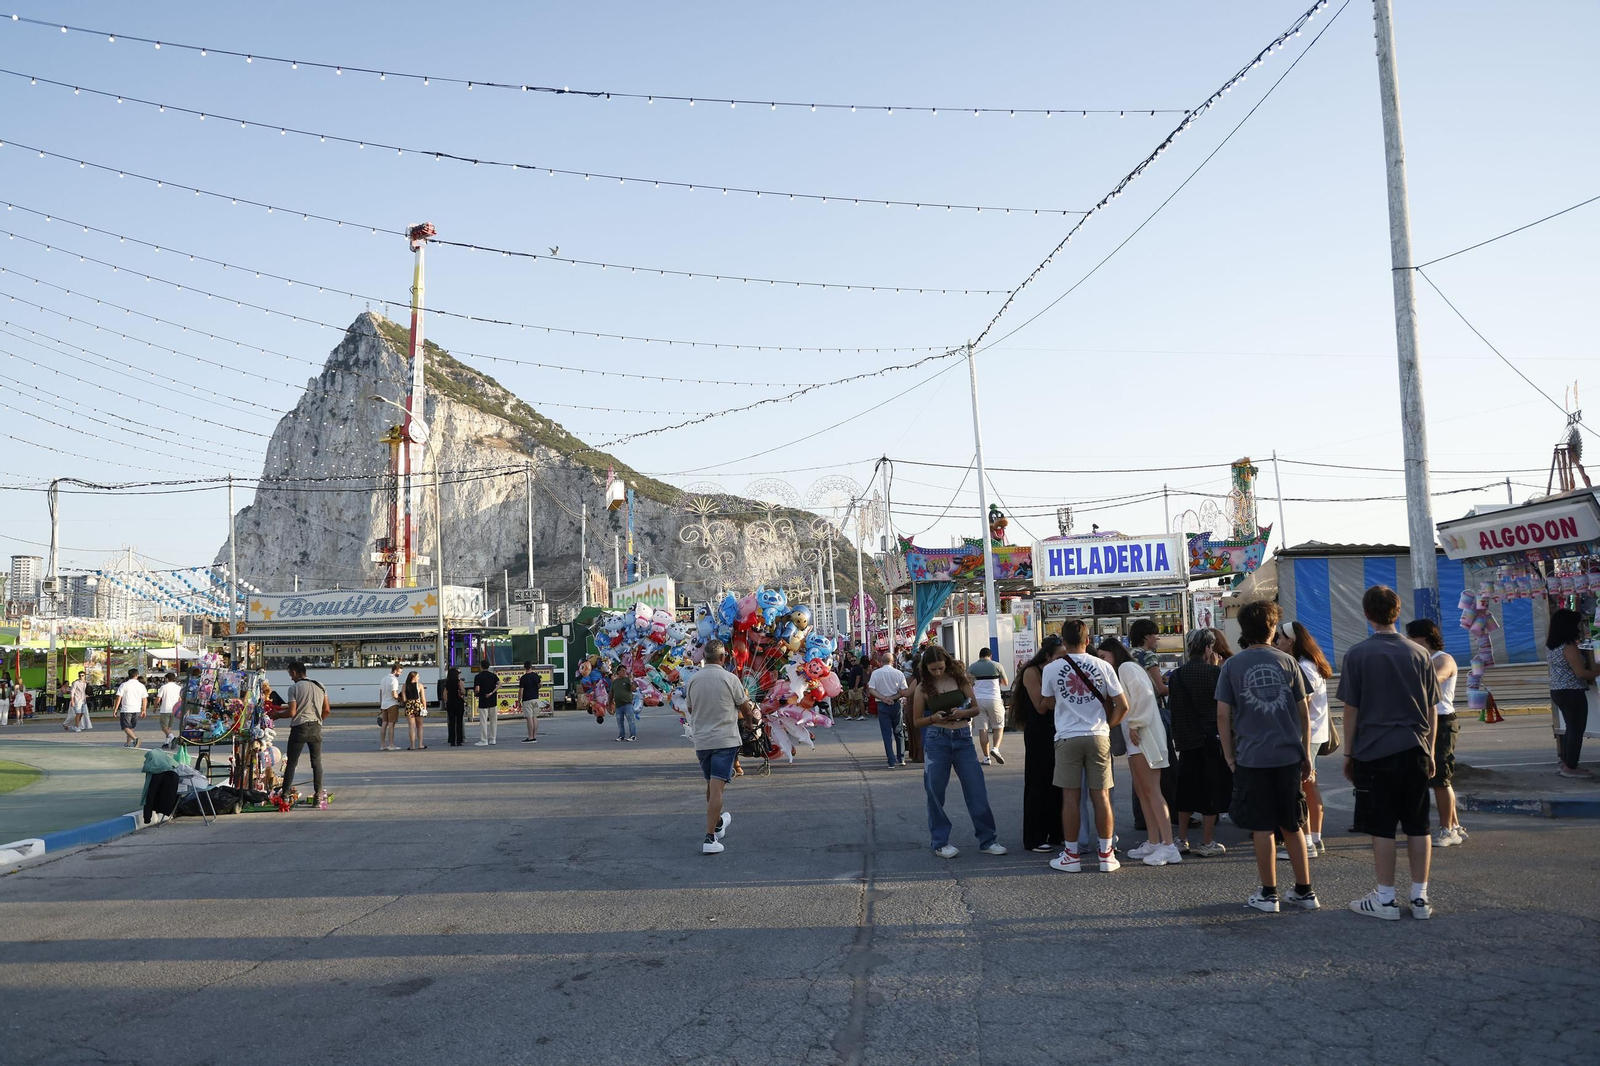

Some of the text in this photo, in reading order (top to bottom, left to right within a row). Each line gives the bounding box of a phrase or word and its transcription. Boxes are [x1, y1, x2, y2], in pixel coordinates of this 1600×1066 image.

[1479, 517, 1578, 550] ALGODON
[1048, 542, 1170, 577] HELADERIA
[277, 594, 409, 618] Beautiful
[616, 584, 664, 608] Helados
[1058, 664, 1071, 678] HO
[1076, 661, 1101, 678] CHILI
[1057, 679, 1070, 699] RED
